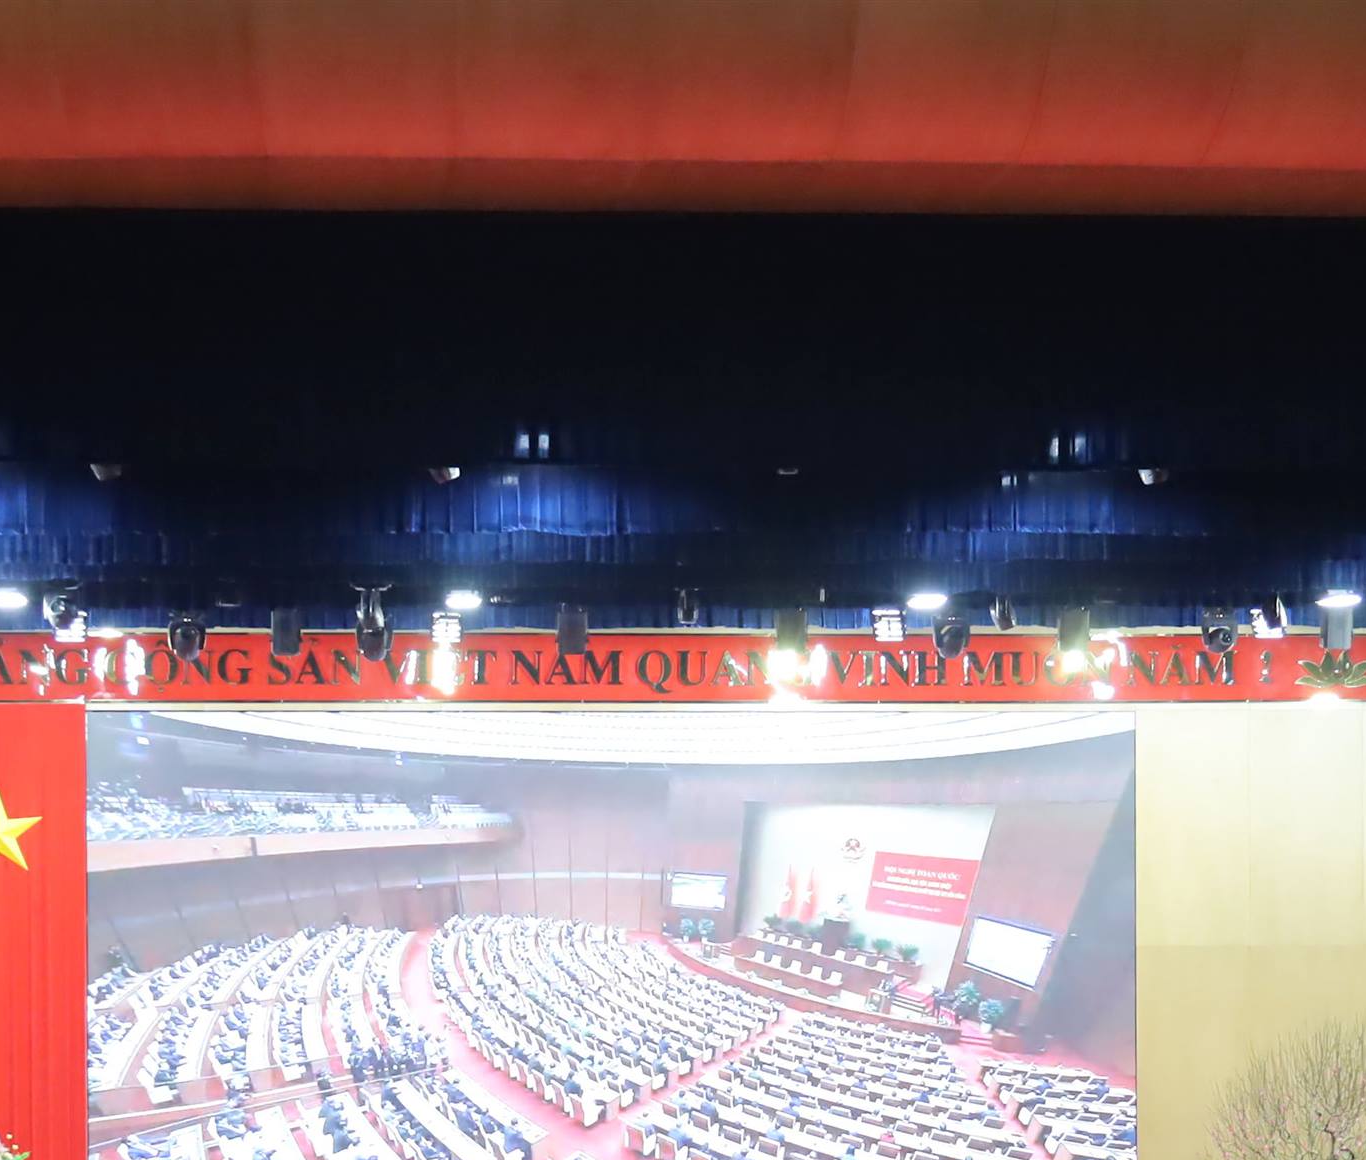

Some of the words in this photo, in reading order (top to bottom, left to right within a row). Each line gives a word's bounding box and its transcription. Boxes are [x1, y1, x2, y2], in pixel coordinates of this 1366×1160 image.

[384, 648, 497, 688] VIT
[512, 649, 624, 686] NAM
[636, 649, 813, 694] QUAN
[830, 649, 950, 687] VINH
[1128, 644, 1237, 686] NĂM
